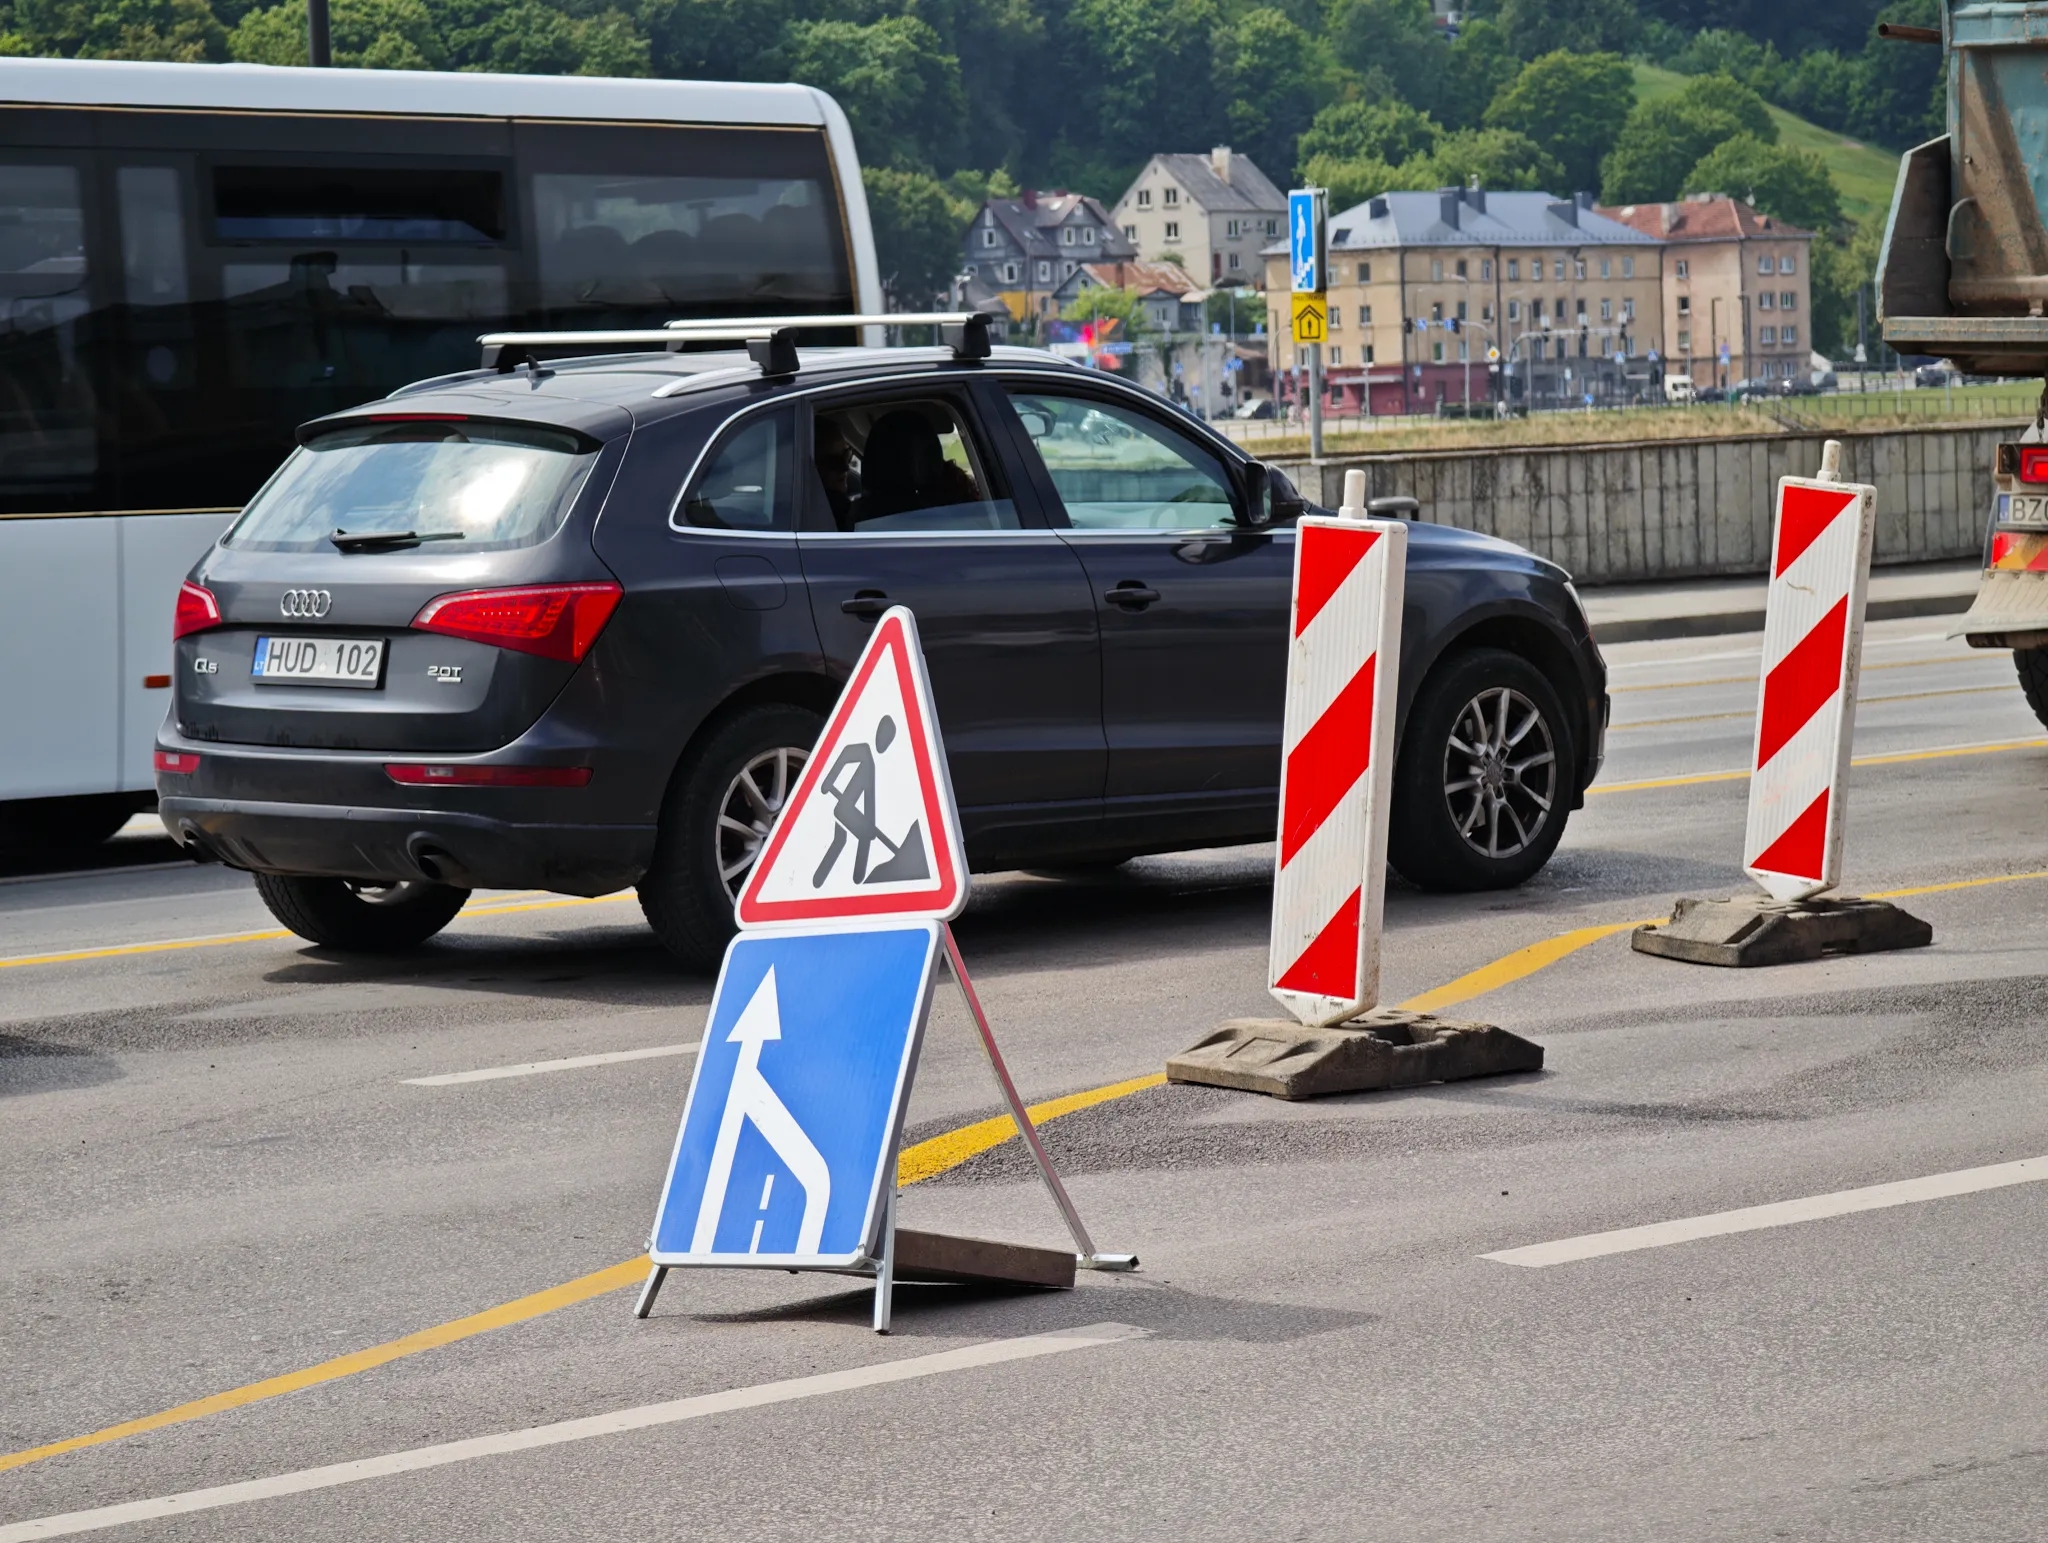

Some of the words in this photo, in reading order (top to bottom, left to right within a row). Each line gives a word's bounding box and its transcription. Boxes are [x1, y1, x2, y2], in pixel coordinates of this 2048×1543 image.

[2012, 498, 2048, 522] BZ
[194, 657, 218, 674] Q5
[254, 661, 265, 670] LT
[267, 641, 317, 673] HUD
[336, 643, 378, 676] 102
